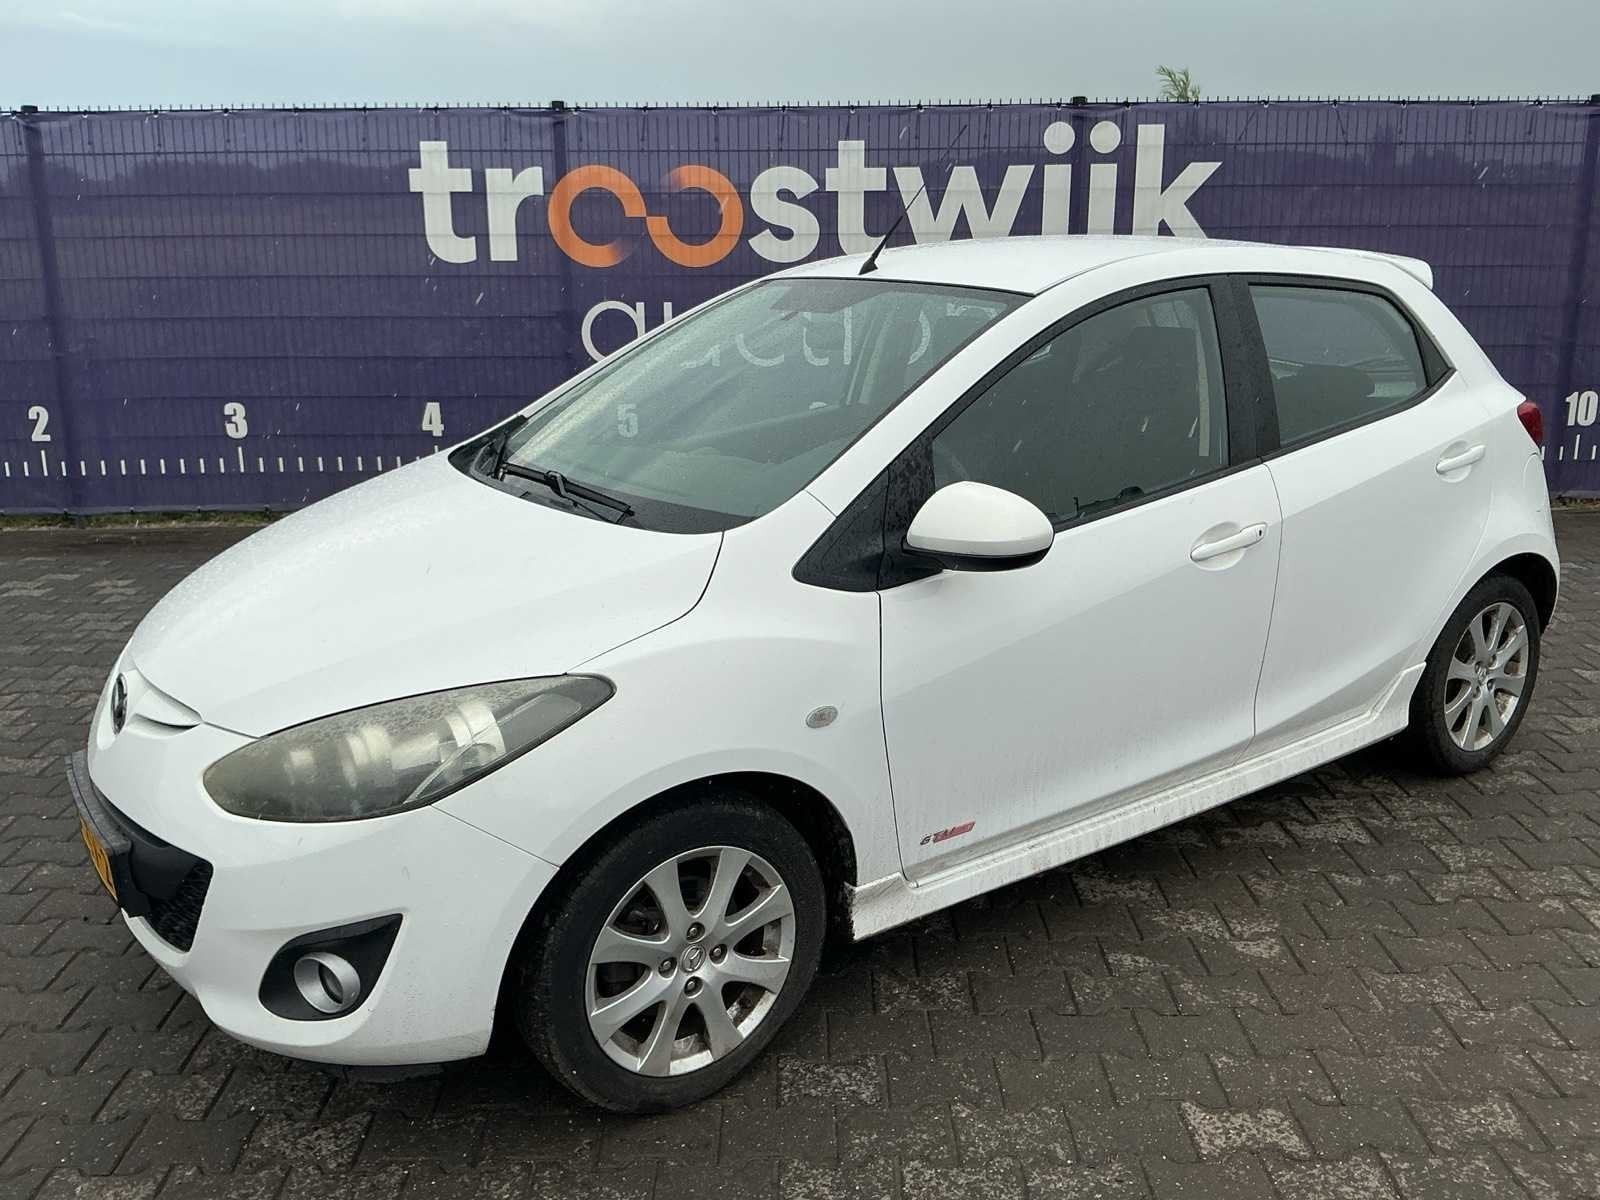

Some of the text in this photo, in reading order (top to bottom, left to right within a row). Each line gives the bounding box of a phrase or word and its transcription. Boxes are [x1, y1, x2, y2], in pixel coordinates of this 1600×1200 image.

[28, 390, 1599, 442] 2 3 4 5 10
